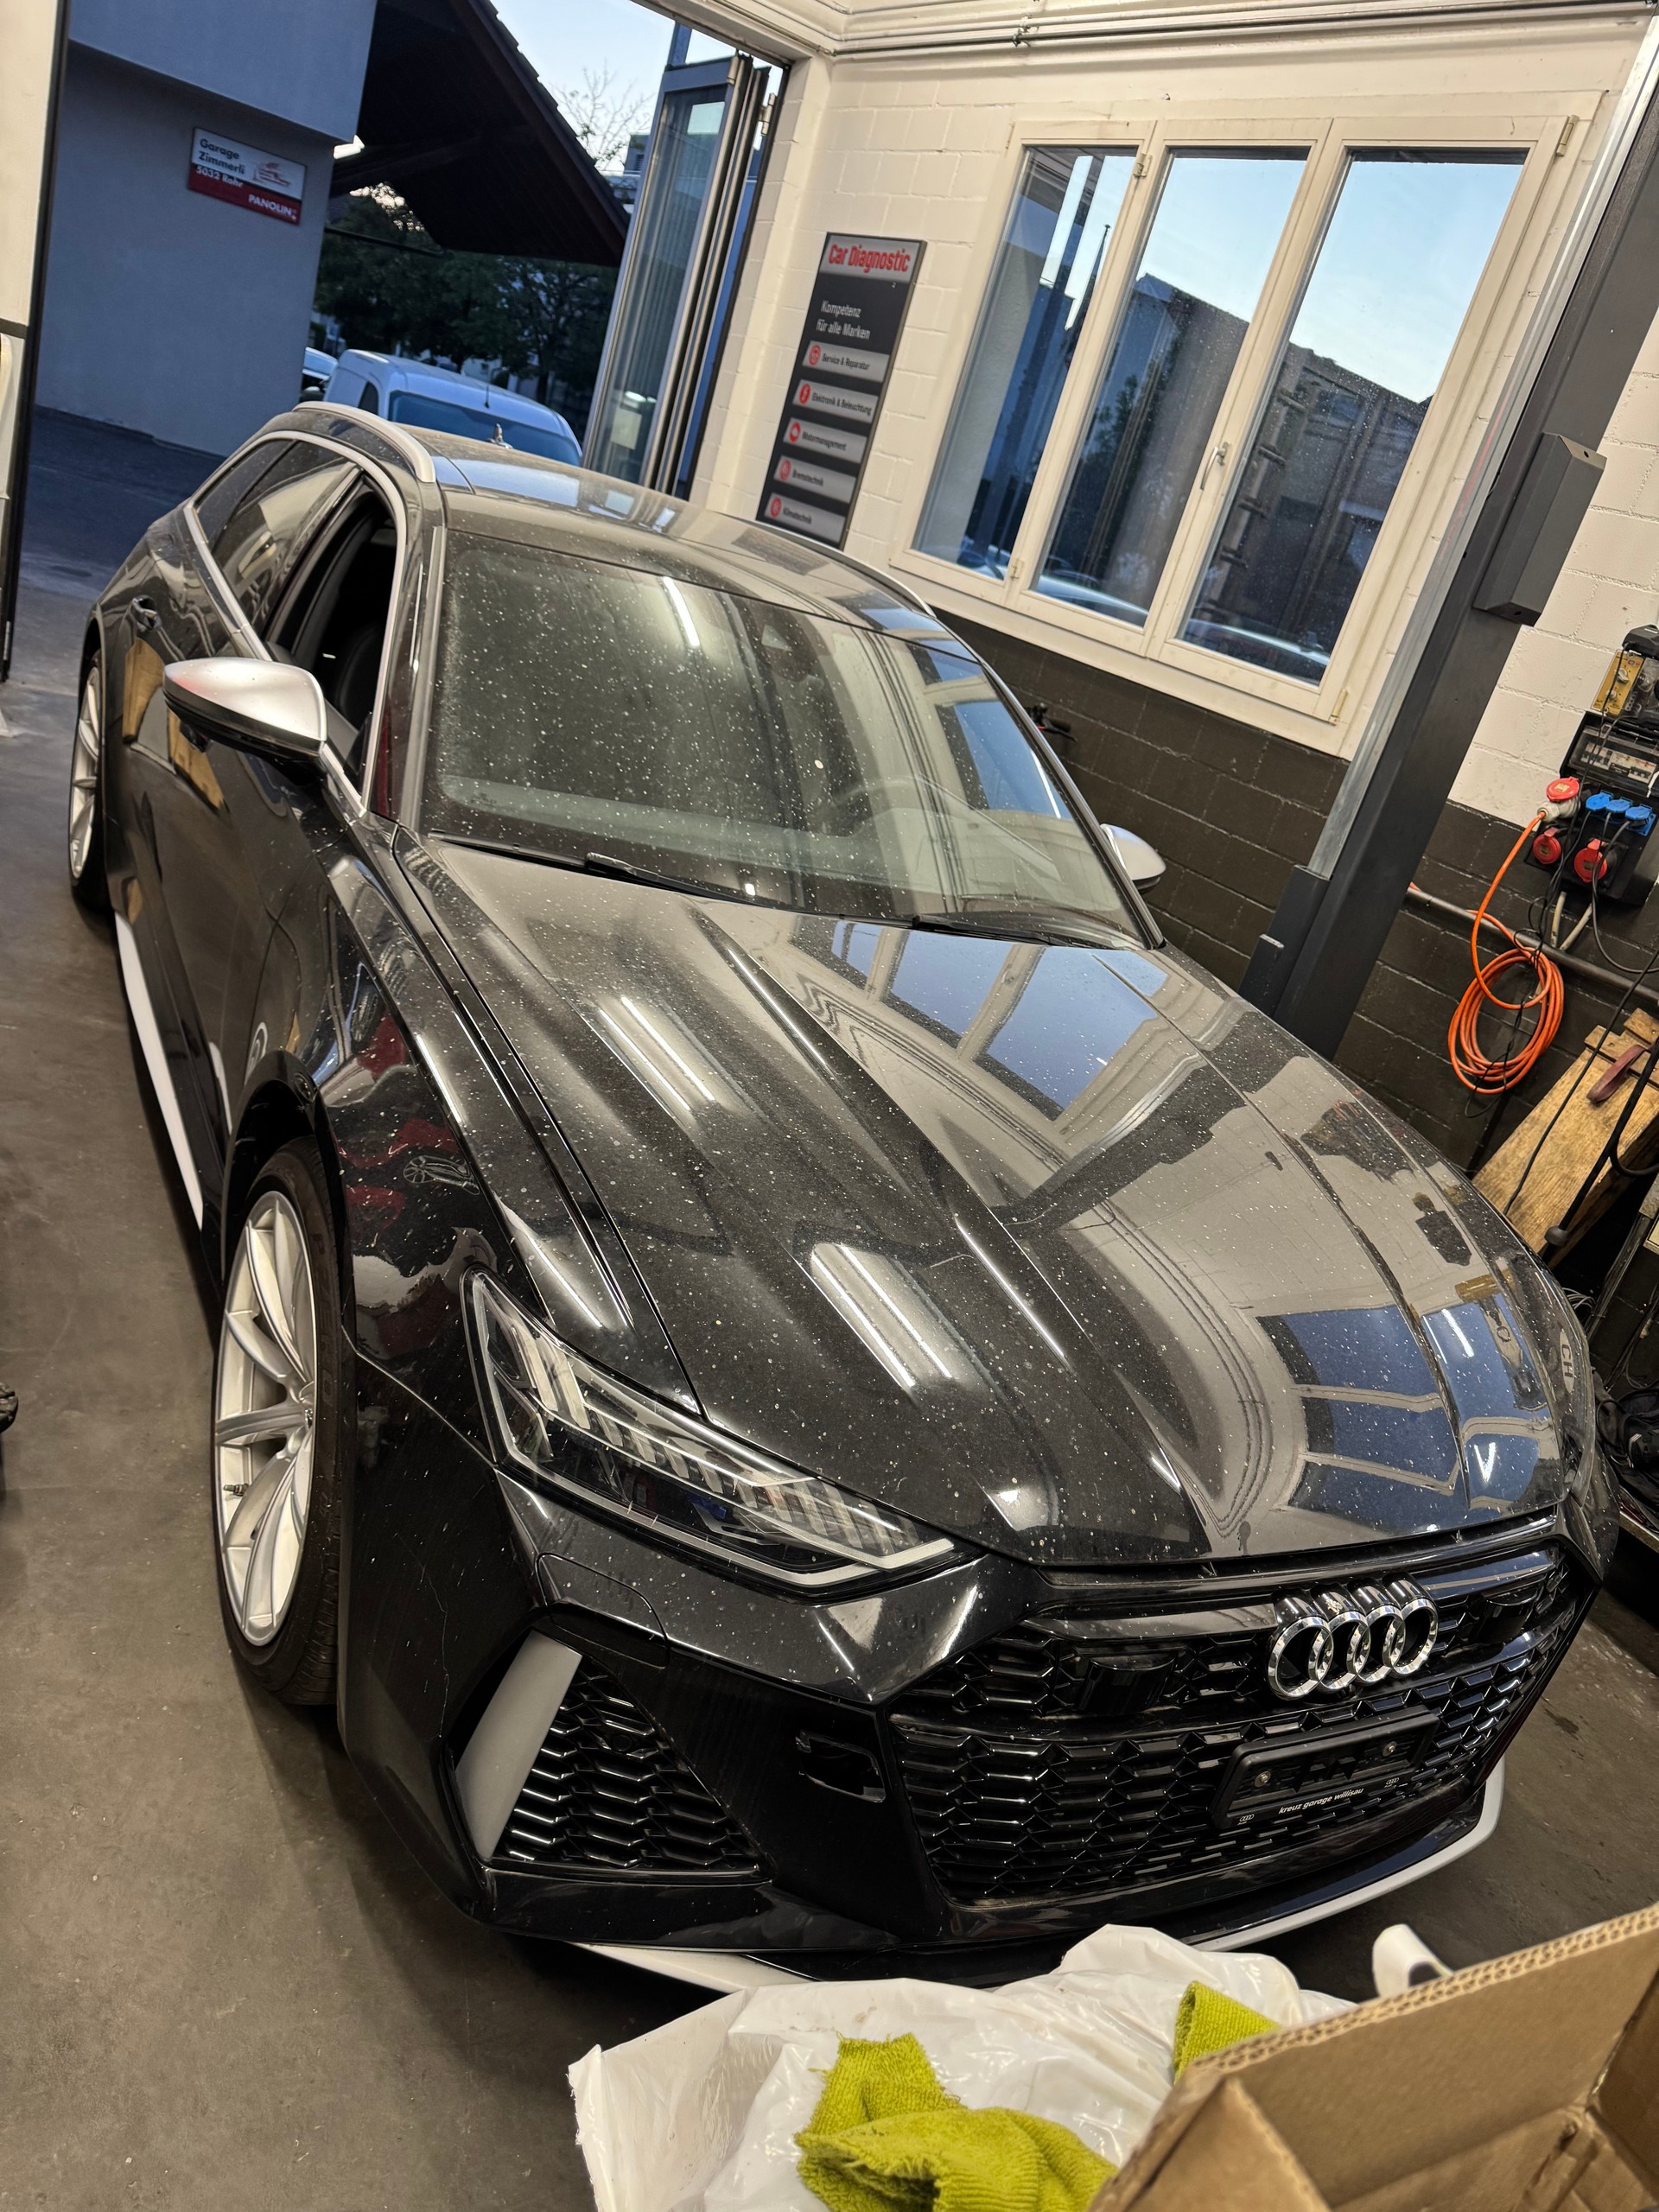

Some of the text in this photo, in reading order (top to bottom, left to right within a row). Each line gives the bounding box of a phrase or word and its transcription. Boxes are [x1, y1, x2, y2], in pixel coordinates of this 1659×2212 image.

[200, 138, 239, 159] Garage
[198, 150, 245, 175] Zimmerli
[248, 194, 292, 216] PANOLIN
[828, 244, 912, 273] Car Diagnostic
[821, 300, 862, 318] Kompetenz
[816, 319, 871, 340] für alle Marken
[822, 353, 840, 365] Service
[845, 357, 870, 371] Reparatur
[1561, 1344, 1573, 1378] CH
[1279, 1788, 1364, 1815] kreuz garage willisau
